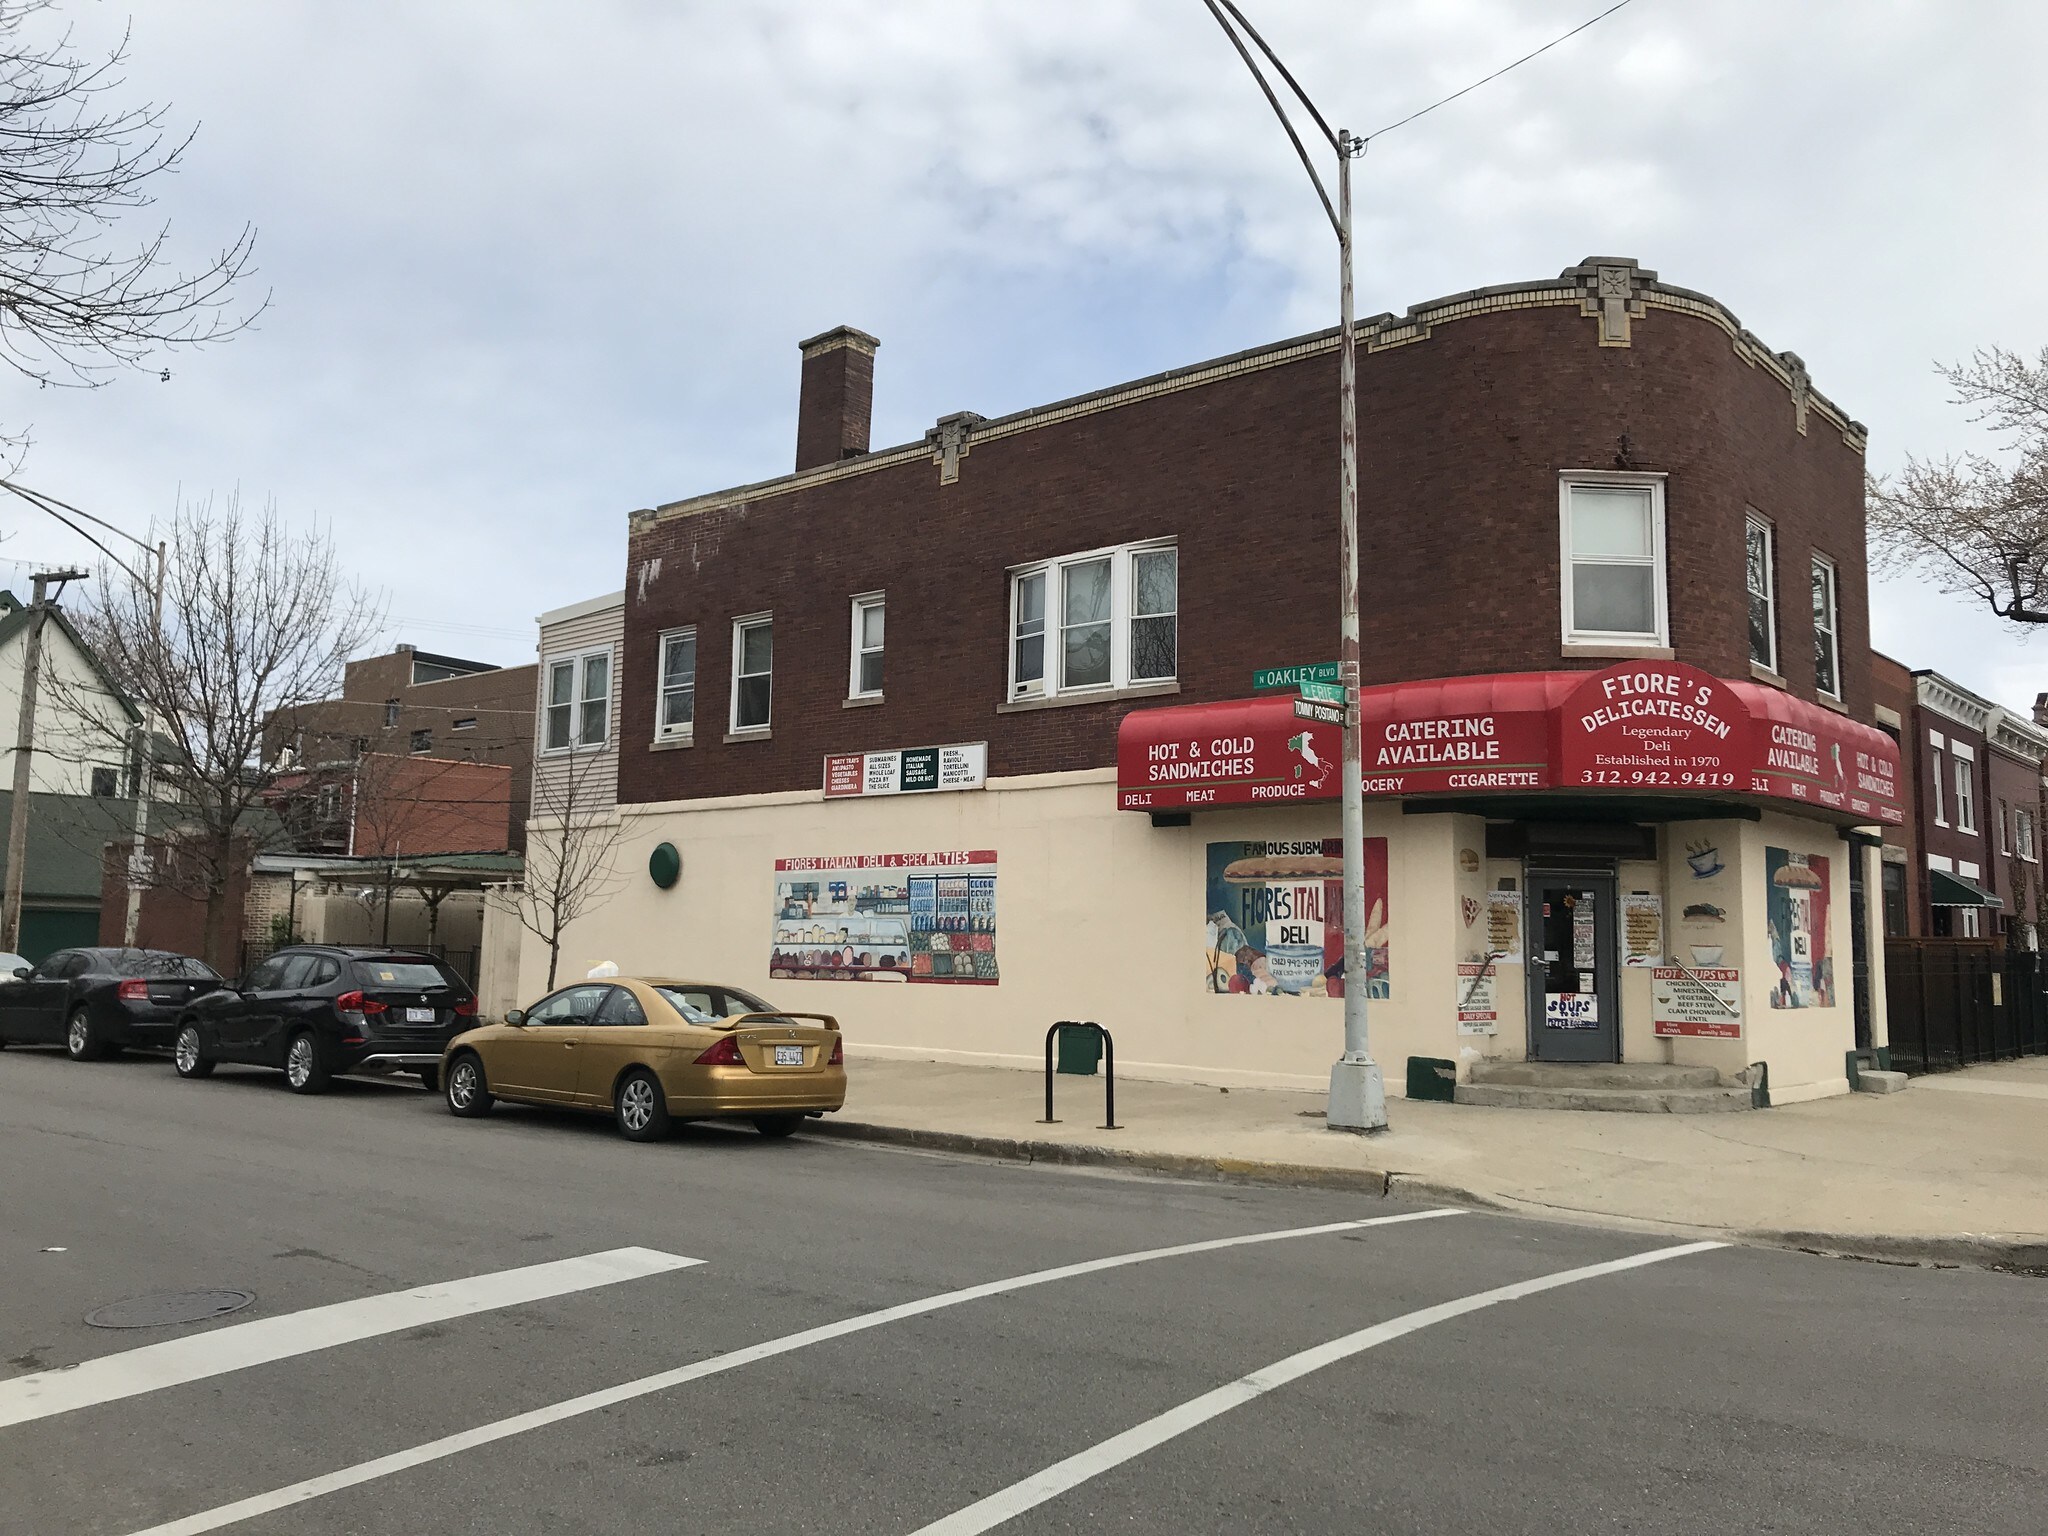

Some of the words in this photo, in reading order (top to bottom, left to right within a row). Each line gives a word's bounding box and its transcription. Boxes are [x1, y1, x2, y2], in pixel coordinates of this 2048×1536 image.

[1259, 675, 1264, 684] N
[1267, 666, 1317, 685] OAKLEY
[1318, 667, 1335, 678] BLVD
[1310, 684, 1333, 700] ERIE
[1601, 673, 1712, 706] FIORE'S
[1294, 700, 1314, 717] TOMMY
[1314, 705, 1339, 722] POSITANO
[1580, 699, 1731, 739] DELICATESSEN
[1385, 717, 1494, 742] CATERING
[1622, 725, 1692, 740] Legendary
[1644, 740, 1671, 751] Deli
[1771, 725, 1817, 752] CATERING
[1148, 743, 1179, 761] HOT
[1190, 741, 1200, 758] &
[1211, 736, 1254, 756] COLD
[1376, 740, 1500, 765] AVAILABLE
[869, 755, 897, 763] SUBMARINES
[905, 755, 932, 763] HOMEMADE
[1595, 754, 1670, 765] Established
[1674, 756, 1687, 766] in
[1691, 756, 1720, 767] 1970
[1767, 747, 1819, 775] AVAILABLE
[1856, 751, 1869, 770] HOT
[1871, 756, 1877, 773] &
[1878, 758, 1894, 778] COLD
[831, 770, 858, 778] VEGETABLES
[905, 768, 927, 776] SAUSAGE
[943, 769, 969, 777] MANICOTTI
[1149, 757, 1255, 781] SANDWICHES
[1580, 769, 1735, 786] 312.942.9419
[963, 775, 976, 783] MEAT
[1857, 772, 1895, 798] SANDWICHES
[1125, 793, 1152, 806] DELI
[1186, 789, 1215, 802] MEAT
[1251, 783, 1306, 799] PRODUCE
[1448, 772, 1539, 787] CIGARETTE
[1791, 782, 1807, 798] MEAT
[1819, 789, 1841, 806] PRODUCE
[1851, 798, 1870, 813] GROCERY
[1243, 841, 1290, 856] FAMOUS
[820, 855, 859, 869] ITALIAN
[863, 854, 885, 868] DELI
[889, 857, 897, 867] &
[902, 851, 970, 866] SPECIALTIES
[1280, 925, 1309, 944] DELI
[1794, 936, 1807, 955] DELI
[1271, 957, 1286, 966] (312)
[1655, 969, 1679, 978] HOT
[1680, 969, 1716, 980] SOUPS
[1717, 971, 1726, 980] to
[1547, 1000, 1590, 1012] SOUPS
[1560, 993, 1576, 1002] HOT
[1463, 1012, 1475, 1020] DAILY
[1475, 1012, 1492, 1020] SPECIAL
